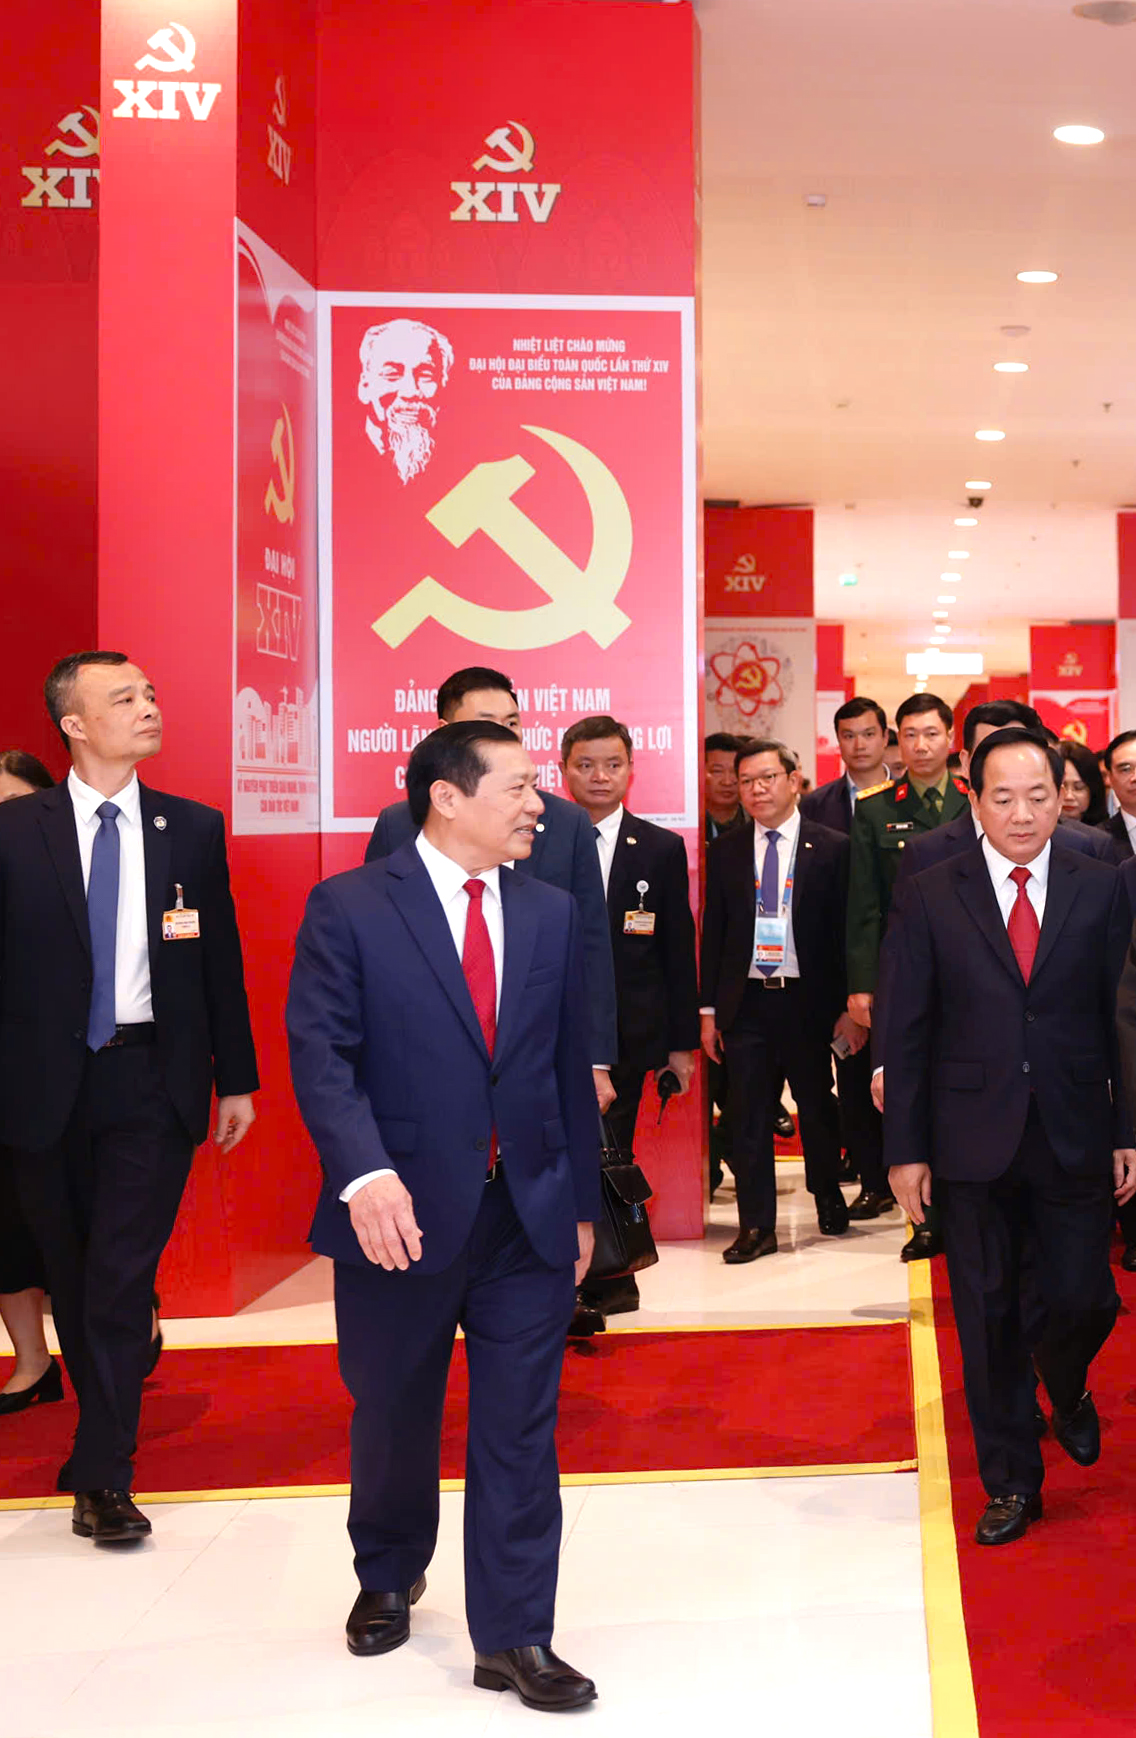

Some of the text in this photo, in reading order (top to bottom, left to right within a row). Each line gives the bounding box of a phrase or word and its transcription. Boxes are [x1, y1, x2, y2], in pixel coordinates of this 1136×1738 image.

[112, 80, 222, 121] XIV
[267, 124, 291, 187] XIV
[21, 166, 100, 208] XI
[450, 181, 562, 223] XIV
[513, 336, 626, 354] NHIỆT LIỆT CHÀO MỪNG
[469, 357, 486, 373] ĐẠI
[489, 356, 506, 374] HỘI
[508, 358, 525, 374] ĐẠI
[527, 354, 550, 372] BIỂU
[553, 357, 579, 372] TOÀN
[581, 356, 608, 373] QUỐC
[632, 356, 651, 373] THỨ
[653, 360, 669, 373] XIV
[492, 372, 647, 393] CỦA ĐẢNG CỘNG SẢN VIỆT NAM!
[724, 575, 766, 592] XIV
[395, 679, 438, 713] ĐẢNG
[533, 684, 568, 716] VIỆT
[572, 688, 611, 712] NAM
[347, 723, 397, 753] NGƯỜI
[522, 721, 552, 751] HỨC
[648, 724, 672, 755] LỢI
